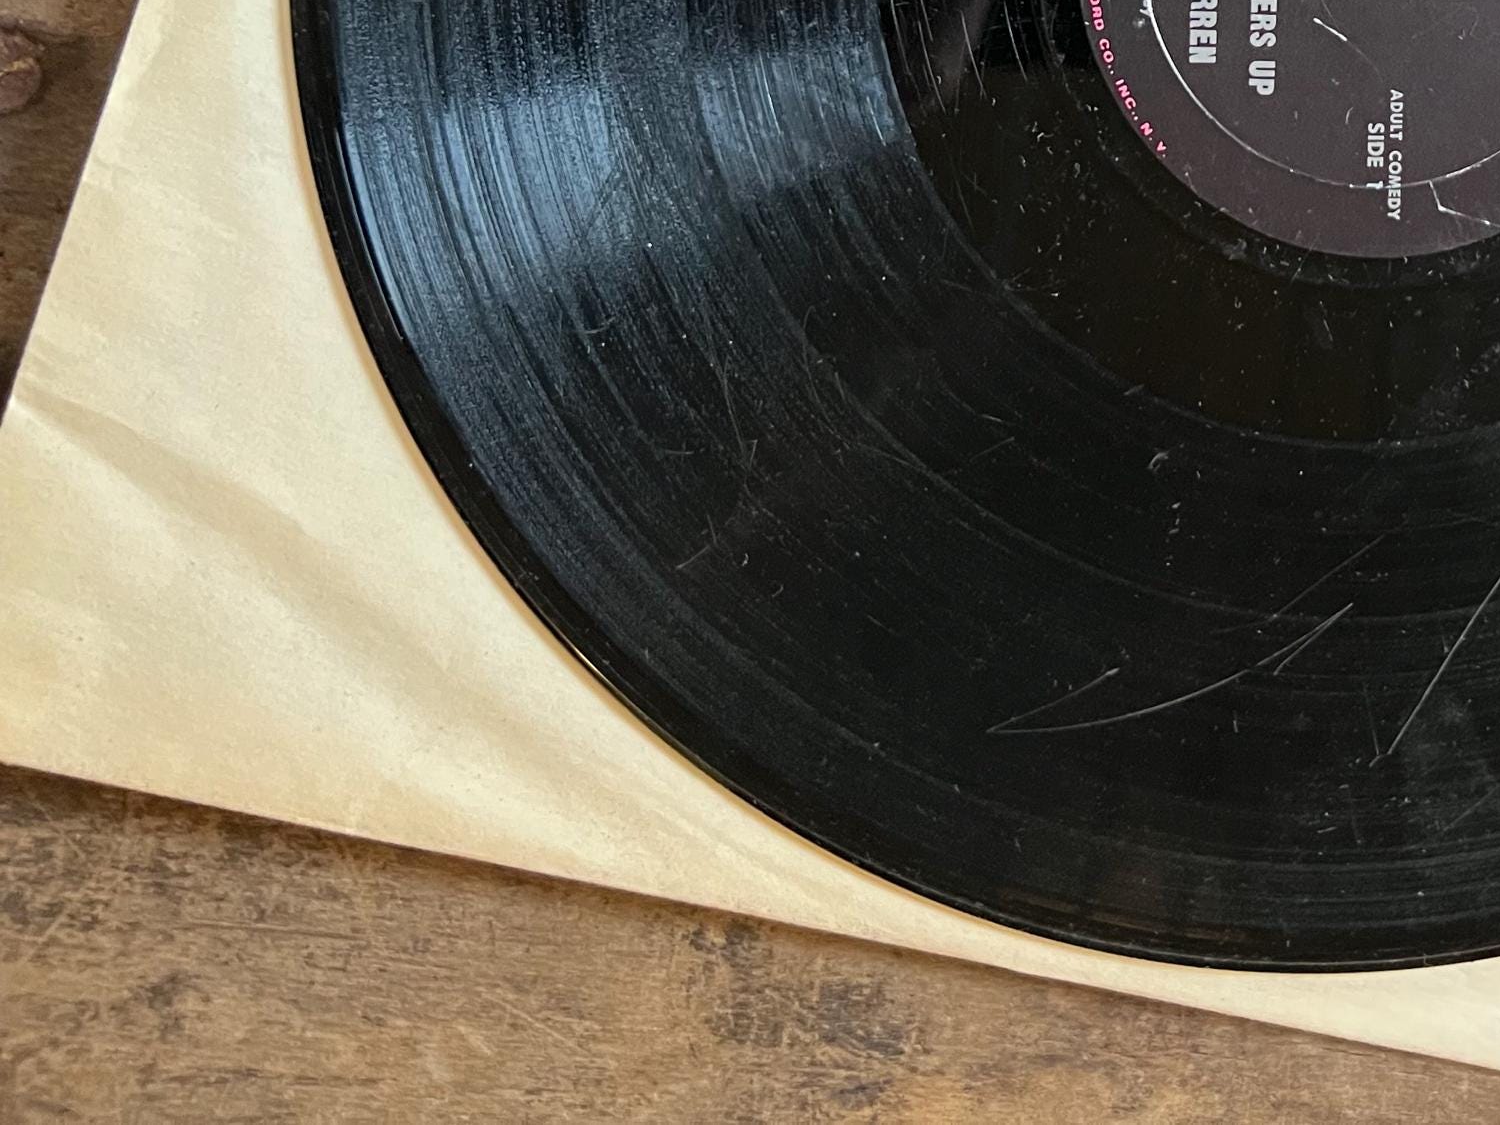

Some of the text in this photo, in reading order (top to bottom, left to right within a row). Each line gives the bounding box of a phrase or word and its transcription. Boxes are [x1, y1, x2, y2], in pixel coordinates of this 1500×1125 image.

[1248, 61, 1276, 95] UP
[1366, 123, 1384, 190] SIDE 1
[1387, 89, 1404, 220] ADULT COMEDY
